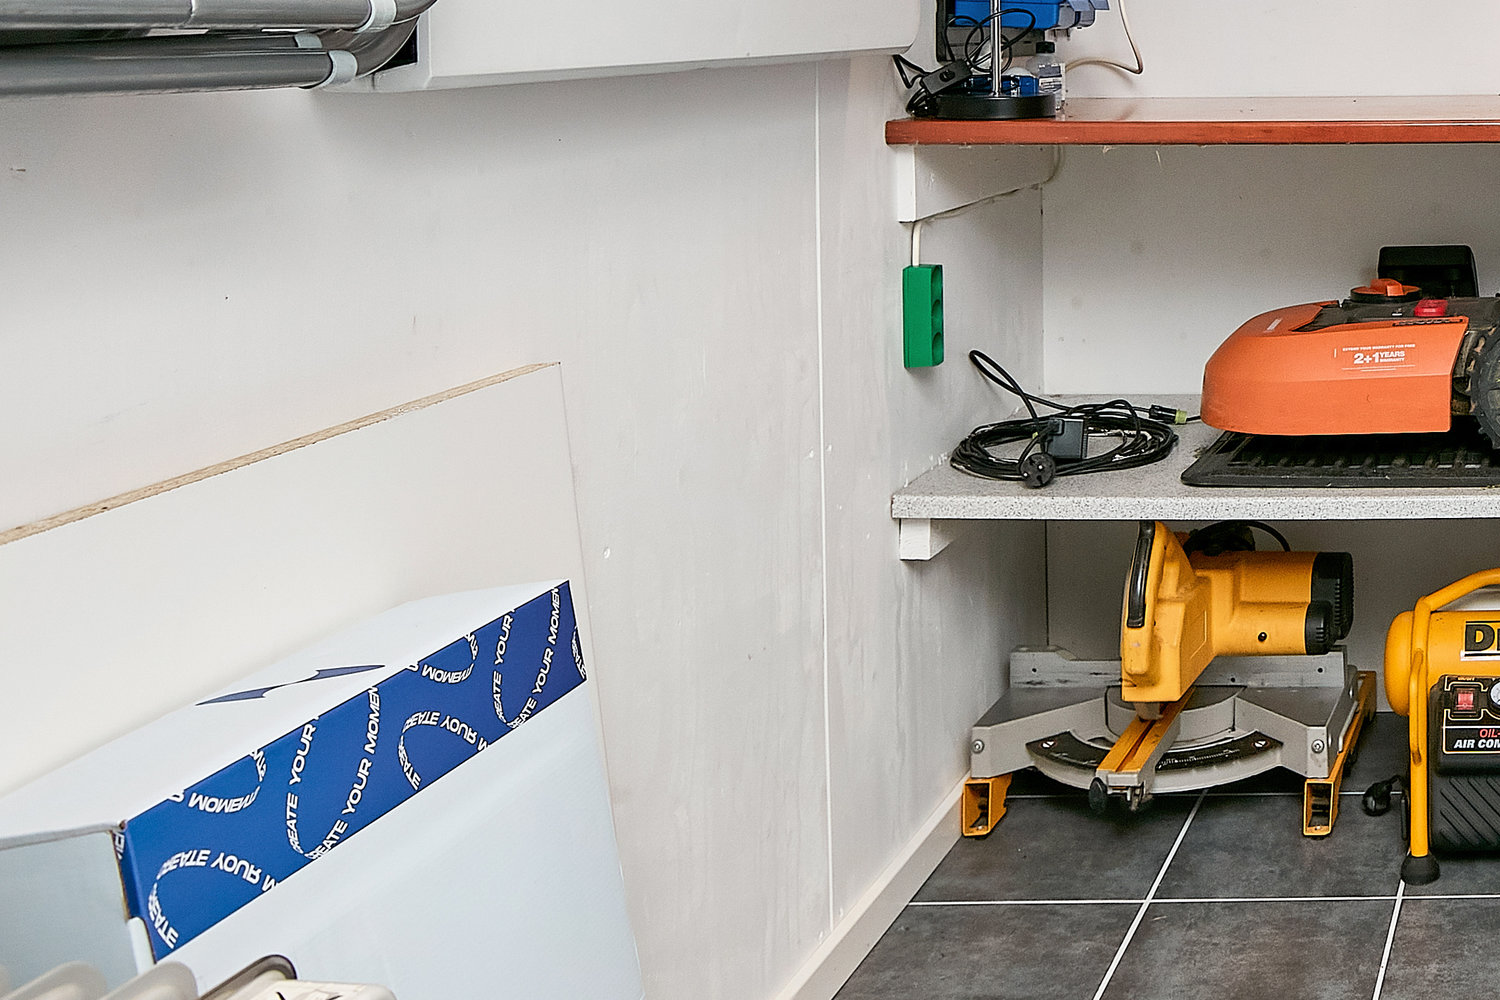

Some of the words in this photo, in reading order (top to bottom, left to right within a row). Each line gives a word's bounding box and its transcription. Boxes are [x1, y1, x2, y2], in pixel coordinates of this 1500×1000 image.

[1353, 352, 1380, 365] 2+1
[1379, 350, 1406, 358] YEARS
[494, 614, 515, 665] YOUR
[532, 647, 554, 694] YOUR
[289, 723, 317, 785] YOUR
[1453, 739, 1476, 749] AIR
[341, 757, 373, 815] YOUR
